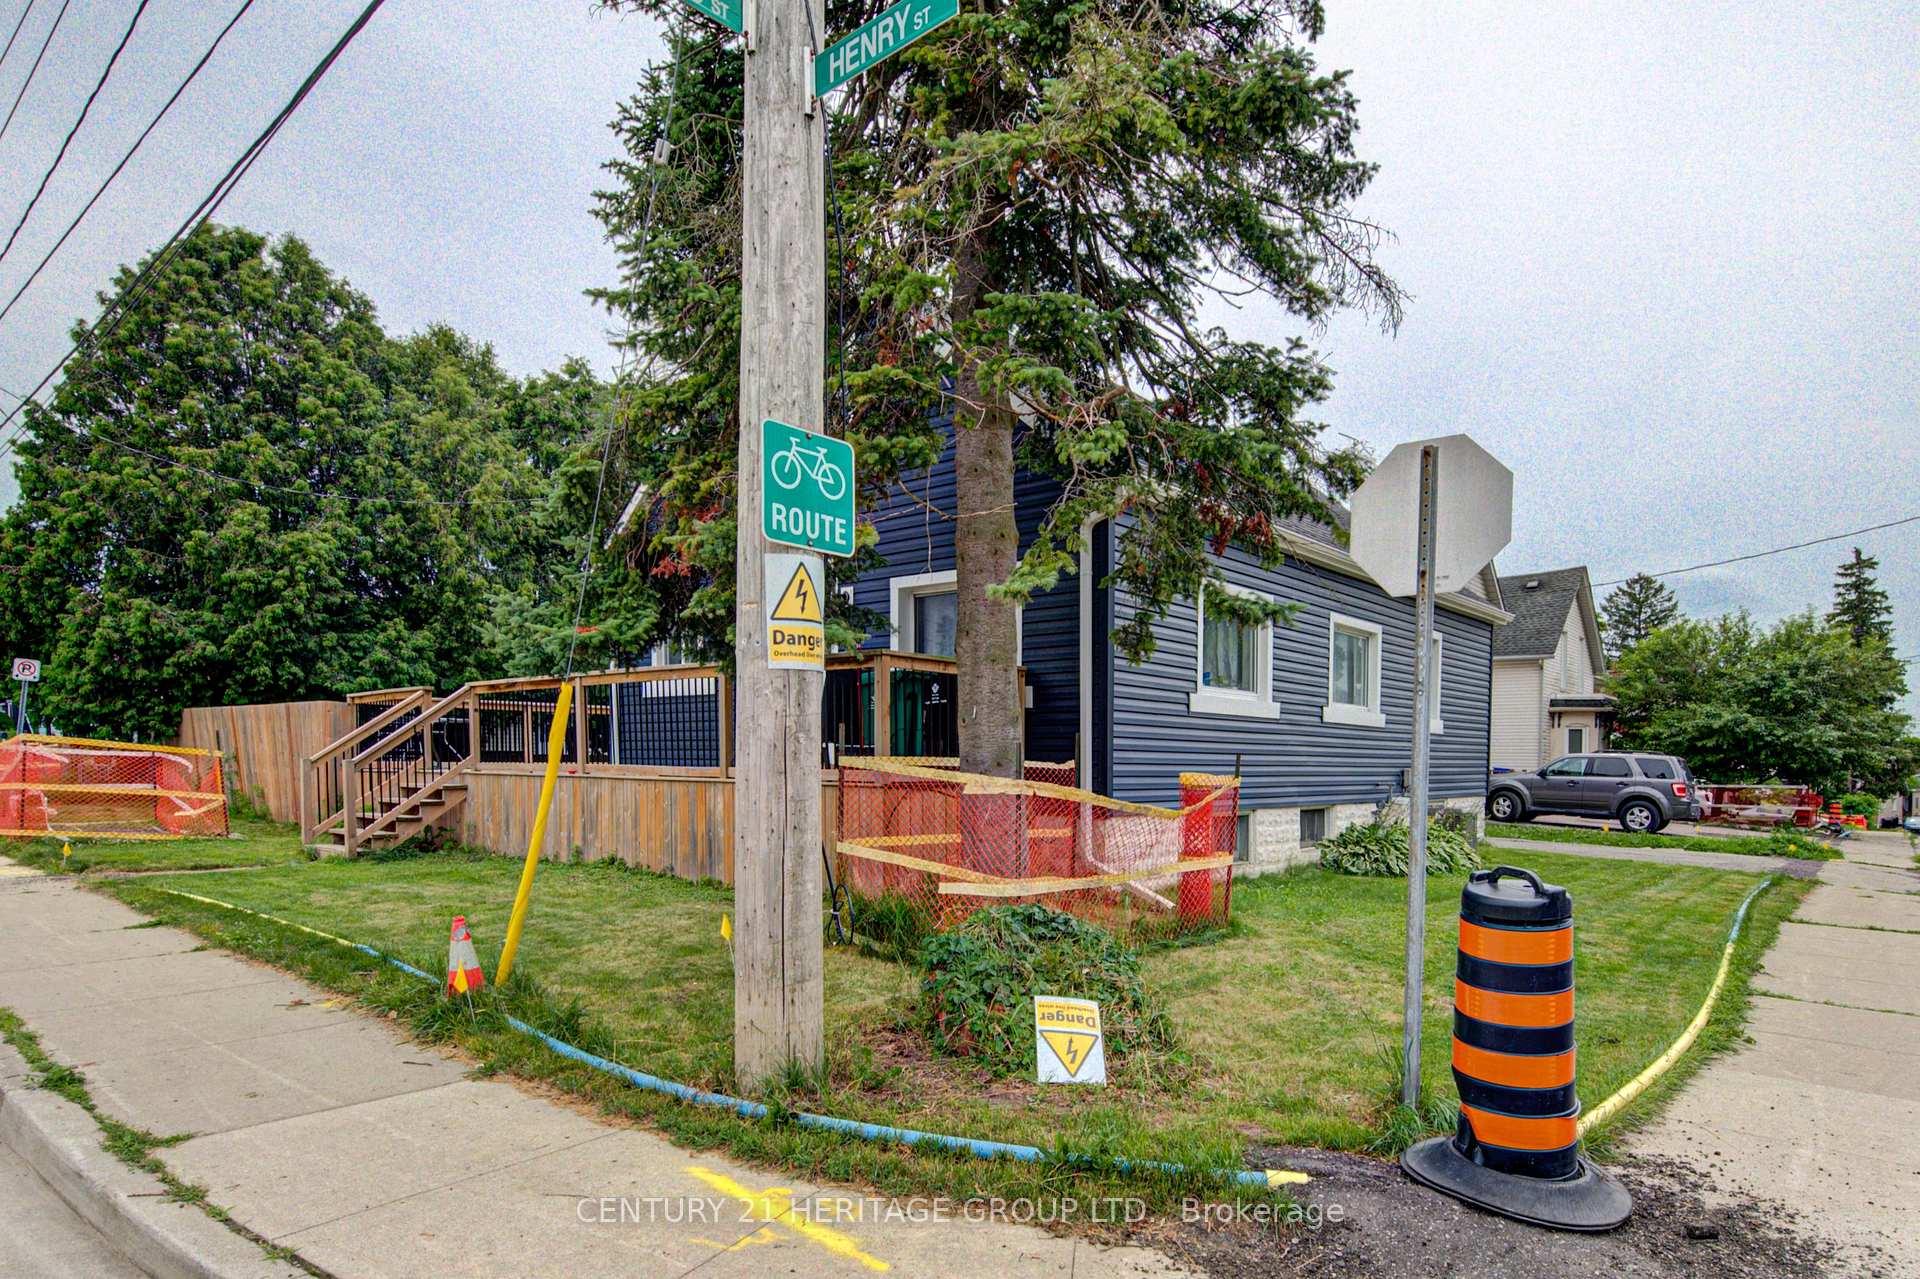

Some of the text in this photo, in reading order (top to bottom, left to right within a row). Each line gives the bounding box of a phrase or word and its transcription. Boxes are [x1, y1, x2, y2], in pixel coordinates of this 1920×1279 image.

[711, 0, 729, 20] ST
[829, 4, 931, 83] HENRY ST
[772, 502, 847, 545] ROUTE
[1040, 1010, 1096, 1028] Danger
